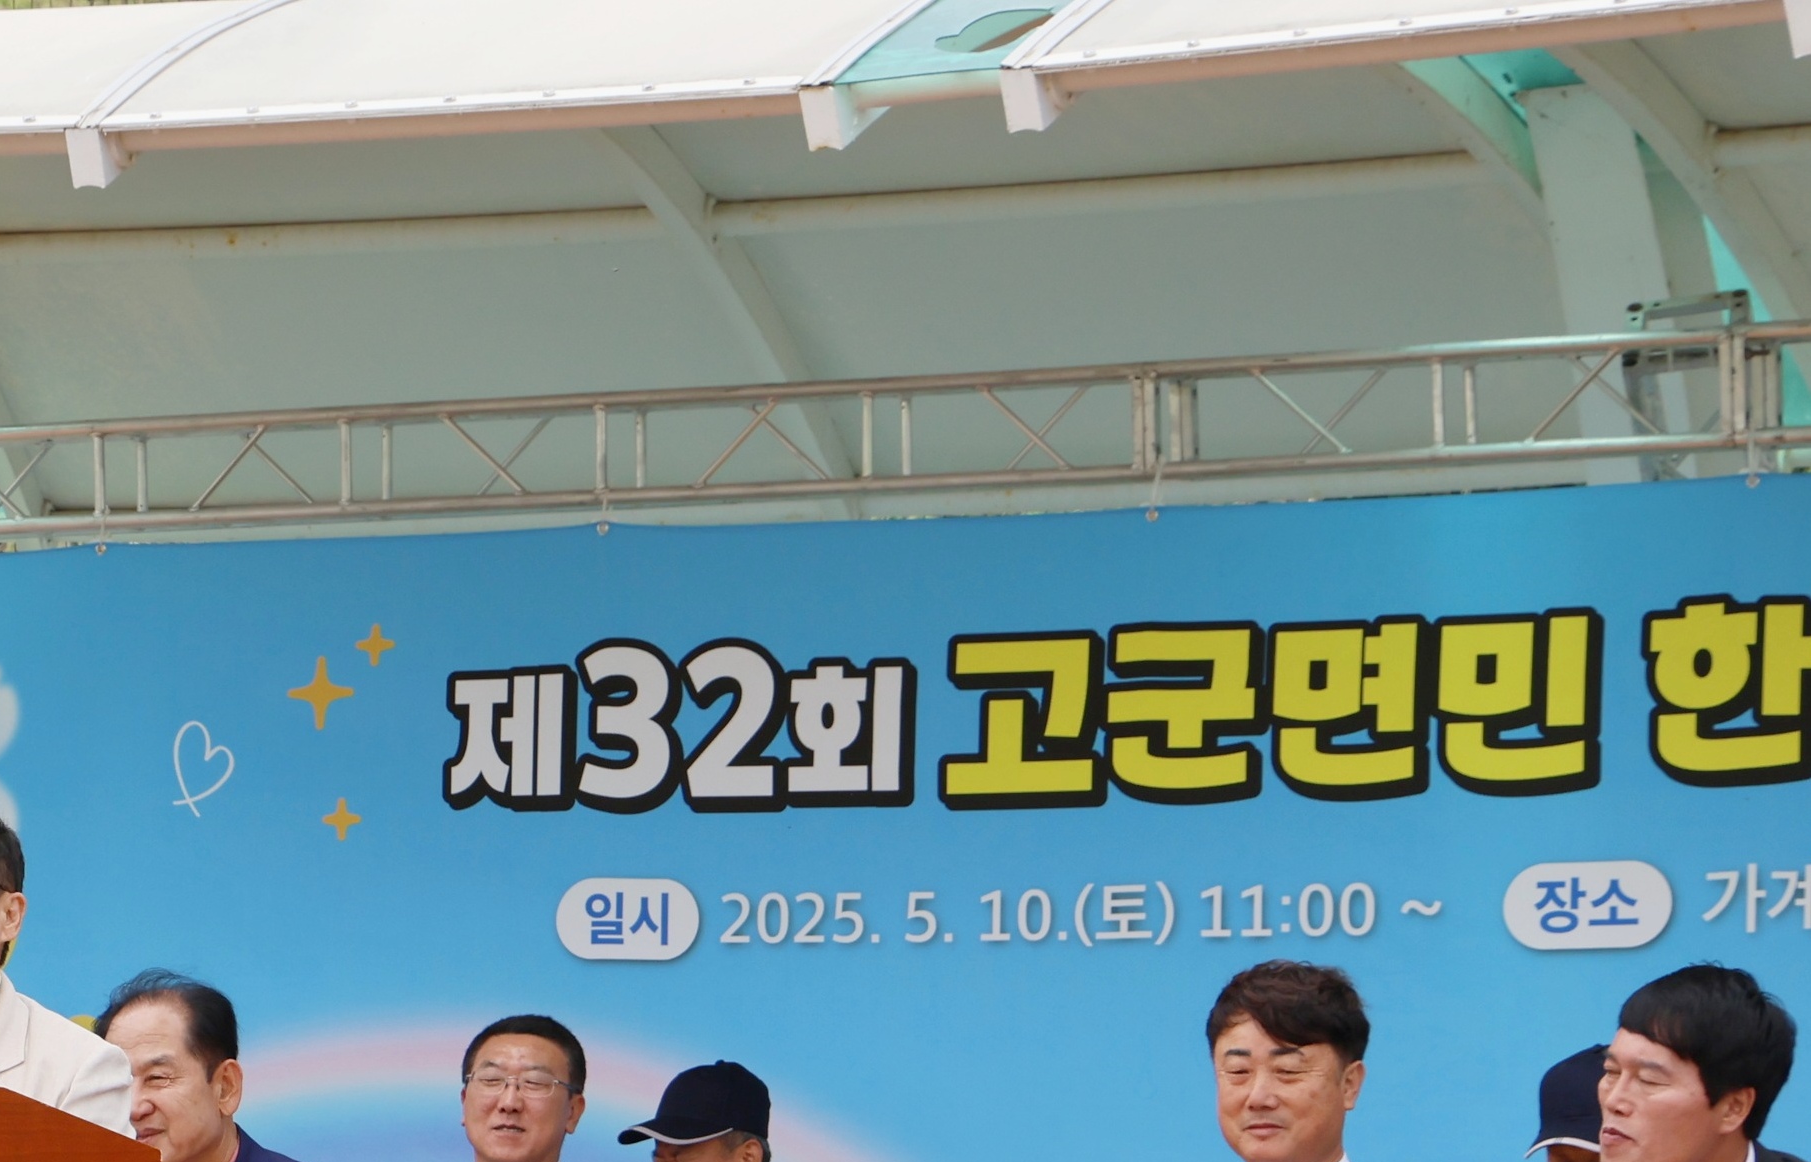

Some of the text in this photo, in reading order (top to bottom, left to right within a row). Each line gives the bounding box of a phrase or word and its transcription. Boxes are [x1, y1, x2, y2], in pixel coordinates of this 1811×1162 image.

[447, 641, 912, 809] 제32회
[942, 610, 1600, 804] 고군면민
[585, 892, 668, 945] 일시
[720, 892, 881, 944] 2025.
[904, 891, 953, 943] 5.
[979, 882, 1175, 946] 10.(토)
[1200, 882, 1376, 937] 11:00
[1534, 873, 1639, 935] 장소
